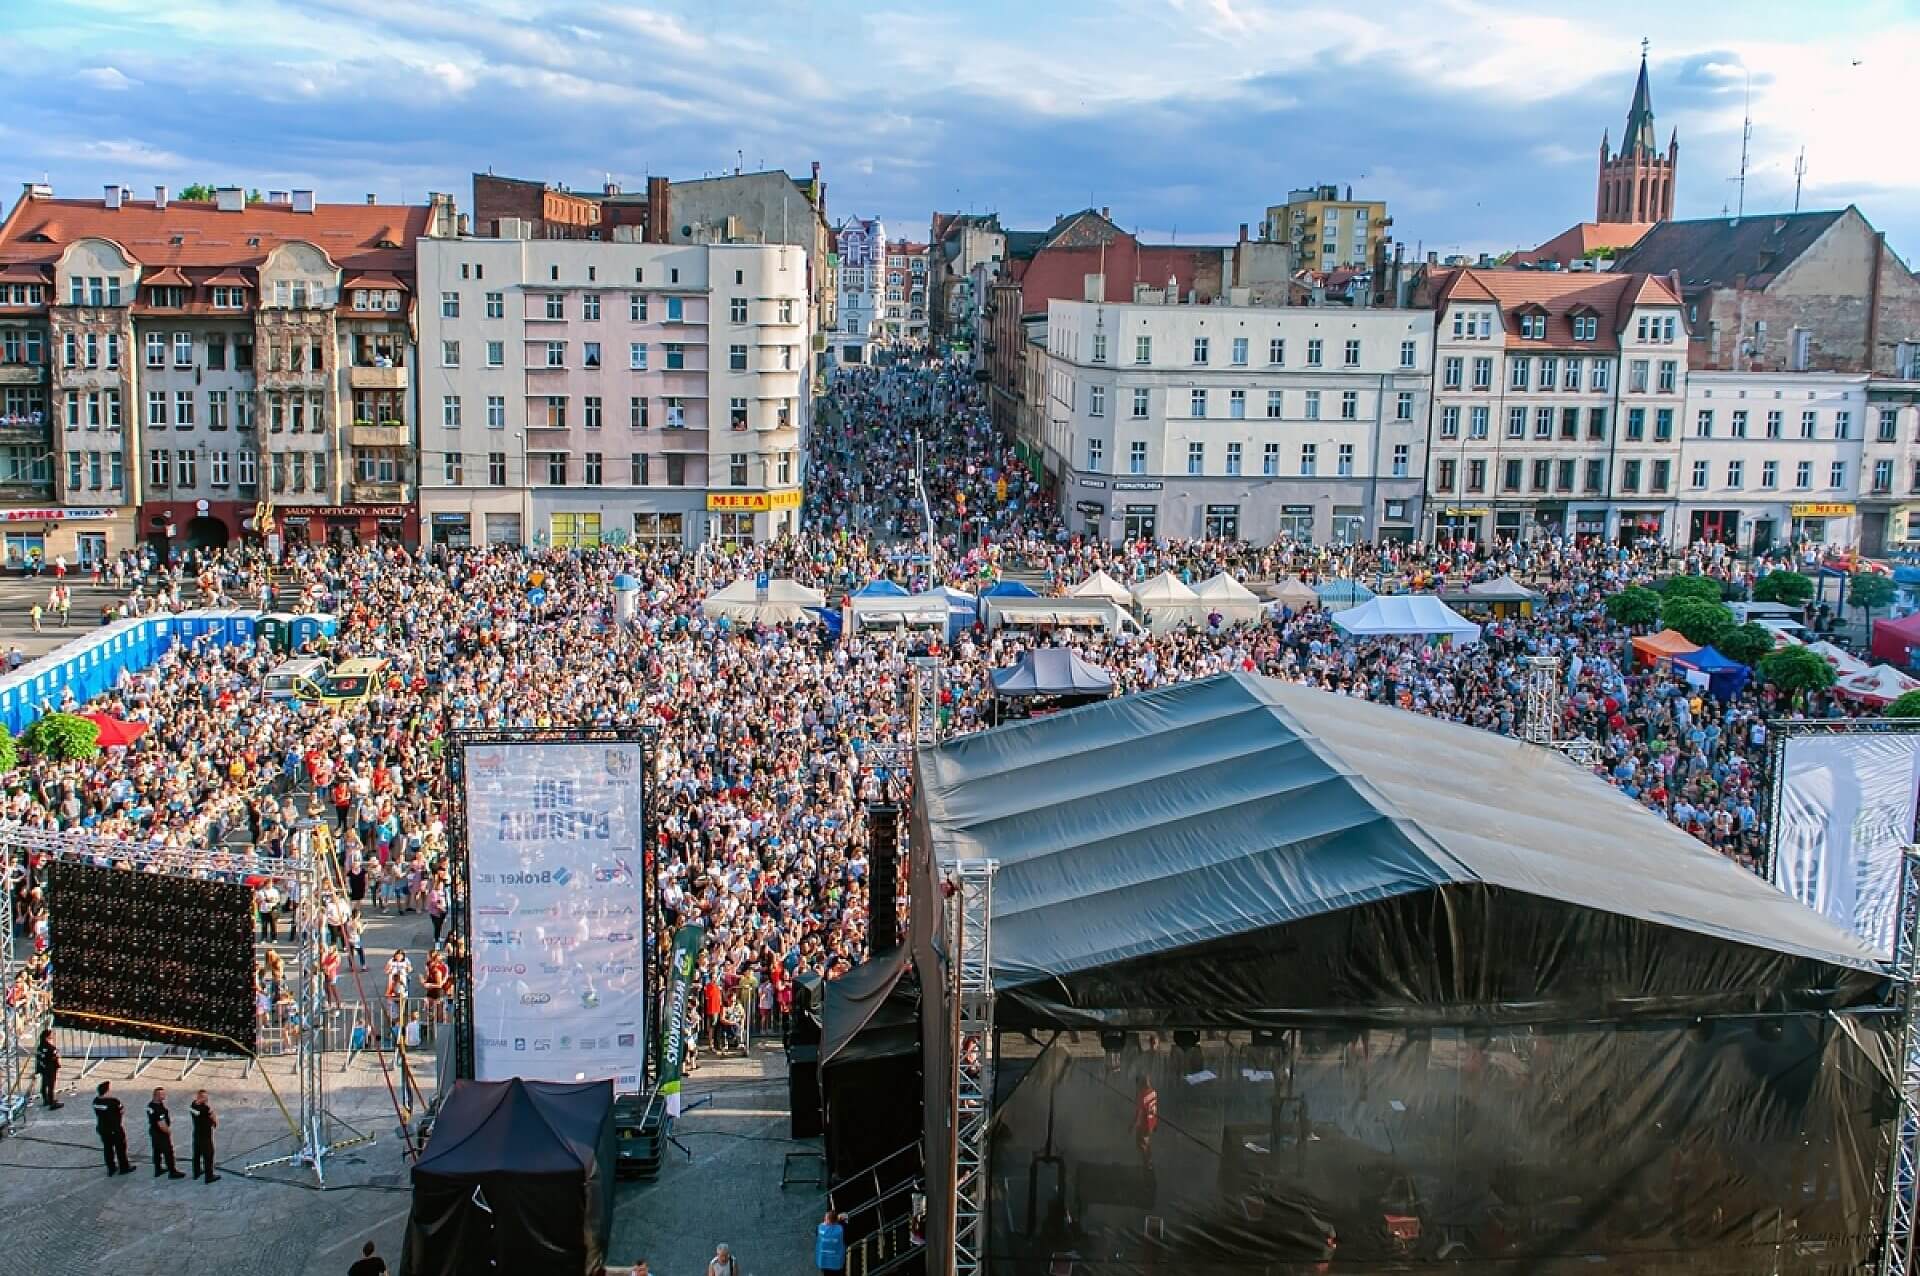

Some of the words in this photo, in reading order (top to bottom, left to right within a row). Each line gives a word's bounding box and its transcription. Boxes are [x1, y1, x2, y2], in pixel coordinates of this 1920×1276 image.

[712, 495, 764, 506] META
[285, 507, 316, 515] SALON
[319, 507, 366, 515] OPTYCZNY
[1815, 505, 1849, 513] META
[7, 510, 65, 520] APTEKA
